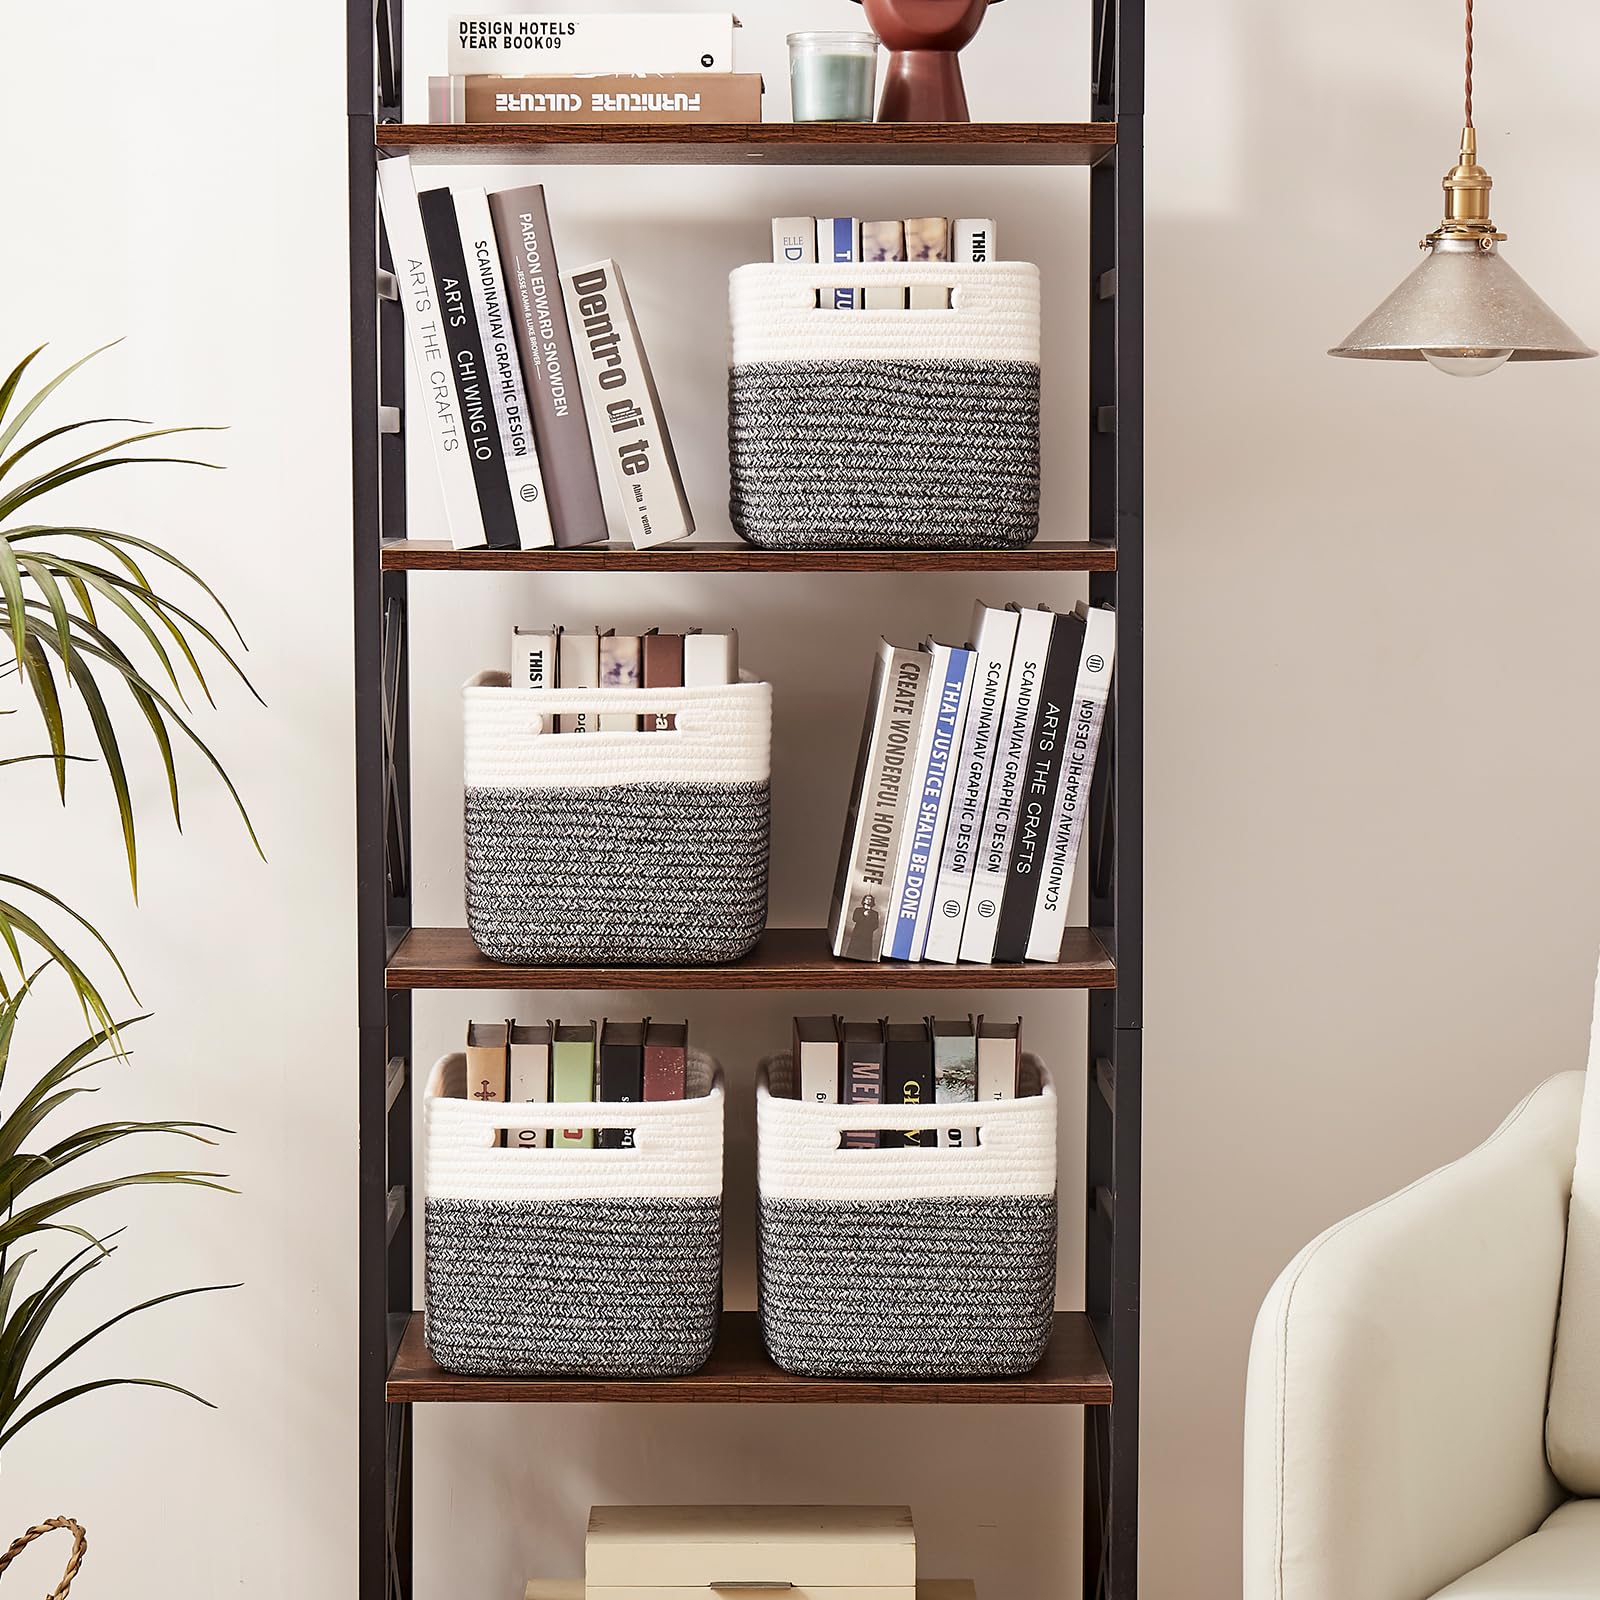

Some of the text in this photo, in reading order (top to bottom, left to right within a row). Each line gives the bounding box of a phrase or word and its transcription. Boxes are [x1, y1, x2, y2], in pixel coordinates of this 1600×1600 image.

[459, 21, 513, 35] DESIGN
[459, 36, 498, 49] YEAR
[495, 93, 701, 112] FURNITURE CULTURE
[784, 236, 803, 246] ELLE
[972, 230, 986, 262] THIS
[516, 270, 526, 290] JESSE
[520, 290, 530, 313] KAMM
[519, 212, 569, 417] PARDON EDWARD SNOWDEN
[526, 318, 536, 336] LUKE
[572, 268, 627, 390] Dentro
[408, 259, 459, 452] ARTS THE CRAFTS
[442, 278, 492, 460] ARTS CHI WING LO
[474, 240, 528, 457] SCANDINAVIAV GRAPHIC DESIGN
[530, 336, 541, 366] BROWER
[606, 398, 646, 433] di
[618, 439, 650, 476] te
[632, 483, 644, 502] Abita
[641, 514, 652, 534] vento
[530, 650, 542, 681] THIS
[863, 662, 920, 885] CREATE WONDERFUL HOMELIFE
[952, 661, 1002, 874] SCANDINAVIAV GRAPHIC DESIGN
[987, 661, 1036, 874] SCANDINAVIAV GRAPHIC DESIGN
[1016, 702, 1061, 874] ARTS THE CRAFTS
[900, 682, 962, 920] THAT JUSTICE SHALL BE DONE
[1044, 700, 1095, 912] SCANDINAVIAV GRAPHIC DESIGN
